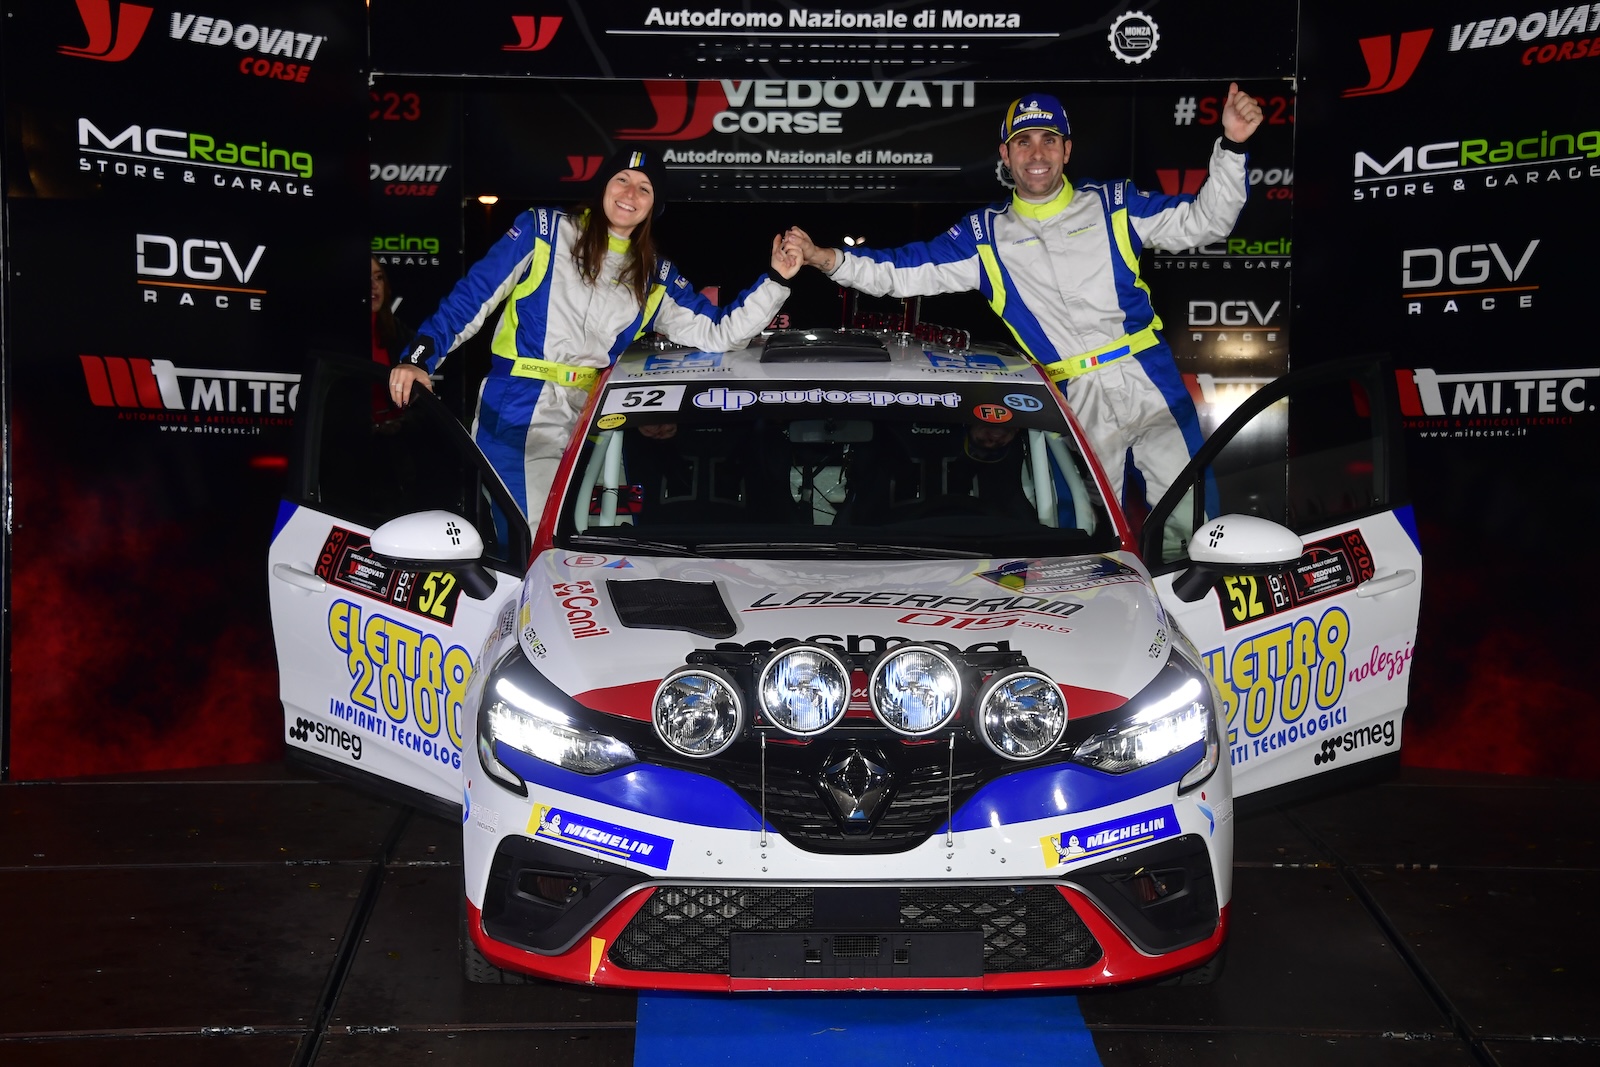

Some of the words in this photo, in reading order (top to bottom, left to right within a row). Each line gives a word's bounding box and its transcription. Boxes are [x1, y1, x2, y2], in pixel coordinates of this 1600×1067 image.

[644, 8, 783, 27] Autodromo
[789, 9, 908, 28] Nazionale
[913, 10, 936, 28] di
[942, 10, 1021, 28] Monza
[169, 12, 323, 61] VEDOVATI
[1124, 26, 1151, 37] MONZA
[1521, 38, 1600, 66] CORSE
[239, 57, 311, 83] CORSE
[719, 80, 975, 108] VEDOVATI
[712, 111, 843, 134] CORSE
[1013, 113, 1053, 126] MICHELIN
[78, 117, 313, 178] MCRacing
[662, 149, 762, 164] Autodromo
[766, 150, 852, 164] Nazionale
[855, 150, 876, 164] di
[878, 151, 933, 164] Monza
[79, 158, 165, 180] STORE
[183, 171, 195, 183] &
[214, 174, 314, 197] GARAGE
[384, 184, 439, 196] CORSE
[1354, 182, 1434, 201] STORE
[1453, 179, 1466, 191] &
[1486, 164, 1600, 188] GARAGE
[970, 214, 983, 241] sparco
[136, 234, 267, 283] DGV
[1154, 261, 1210, 269] STORE
[1402, 239, 1540, 289] DGV
[143, 289, 262, 311] RACE
[1408, 295, 1532, 315] RACE
[1188, 301, 1280, 326] DGV
[1192, 333, 1276, 341] RACE
[521, 364, 549, 374] sparco
[621, 389, 666, 408] 52
[692, 388, 757, 411] dp
[758, 388, 962, 408] autosport
[1007, 395, 1040, 408] SD
[1452, 378, 1596, 416] MI.TEC.
[117, 412, 188, 423] AUTOMOTIVE
[206, 414, 254, 425] ARTICOLI
[980, 406, 1007, 420] FP
[1467, 418, 1520, 428] ARTICOLI
[1526, 416, 1573, 427] TECNICI
[160, 424, 261, 436] www.mitecsnc.it
[1420, 428, 1528, 438] www.mitecsnc.it
[317, 531, 343, 576] 2023
[575, 556, 594, 565] E
[1348, 533, 1374, 580] 2023
[357, 564, 385, 579] VEDOVATI
[1312, 564, 1342, 579] VEDOVATI
[393, 570, 410, 602] DG
[419, 572, 456, 618] 52
[1223, 576, 1264, 621] 52
[750, 591, 1084, 616] LASERPROM
[562, 596, 610, 639] Canil
[1020, 620, 1073, 634] SRLS
[327, 598, 474, 694] ELETTRO
[347, 652, 463, 752] 2000
[330, 698, 386, 737] IMPIANTI
[315, 722, 362, 760] smeg
[1253, 706, 1347, 757] TECNOLOGICI
[1343, 719, 1395, 752] smeg
[564, 822, 654, 855] MICHELIN
[1087, 817, 1164, 848] MICHELIN
